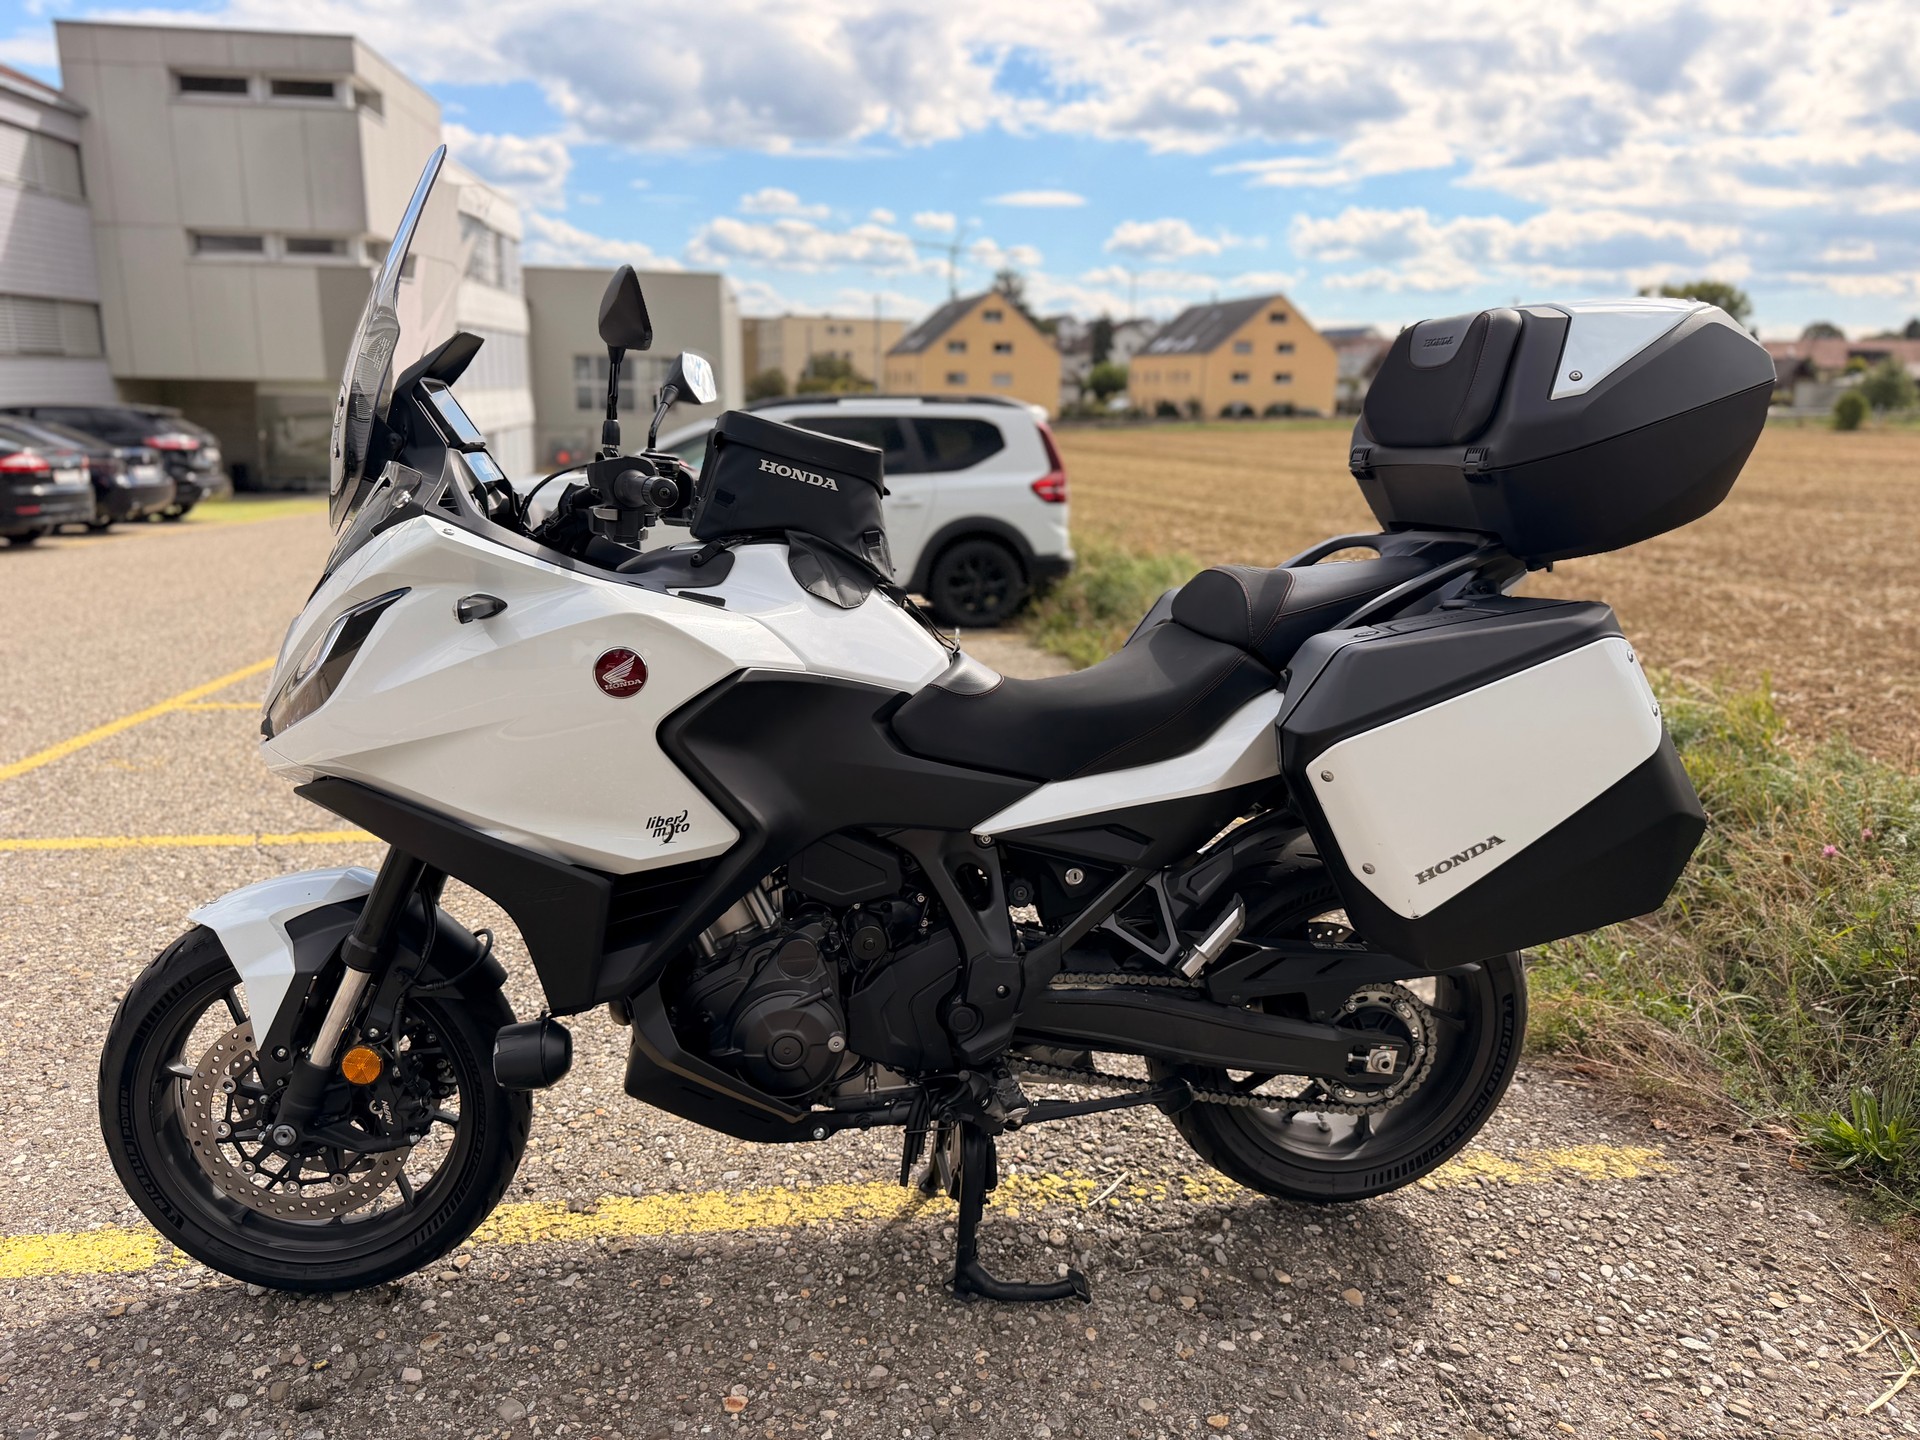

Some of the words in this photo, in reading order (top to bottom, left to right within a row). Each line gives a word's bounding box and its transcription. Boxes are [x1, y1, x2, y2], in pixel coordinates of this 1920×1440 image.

[758, 459, 839, 492] HONDA
[604, 678, 643, 690] HONDA
[1414, 835, 1506, 885] HONDA
[1485, 1015, 1513, 1092] MICHELIN
[1431, 1144, 1442, 1157] 17
[125, 1143, 168, 1208] MICHELIN
